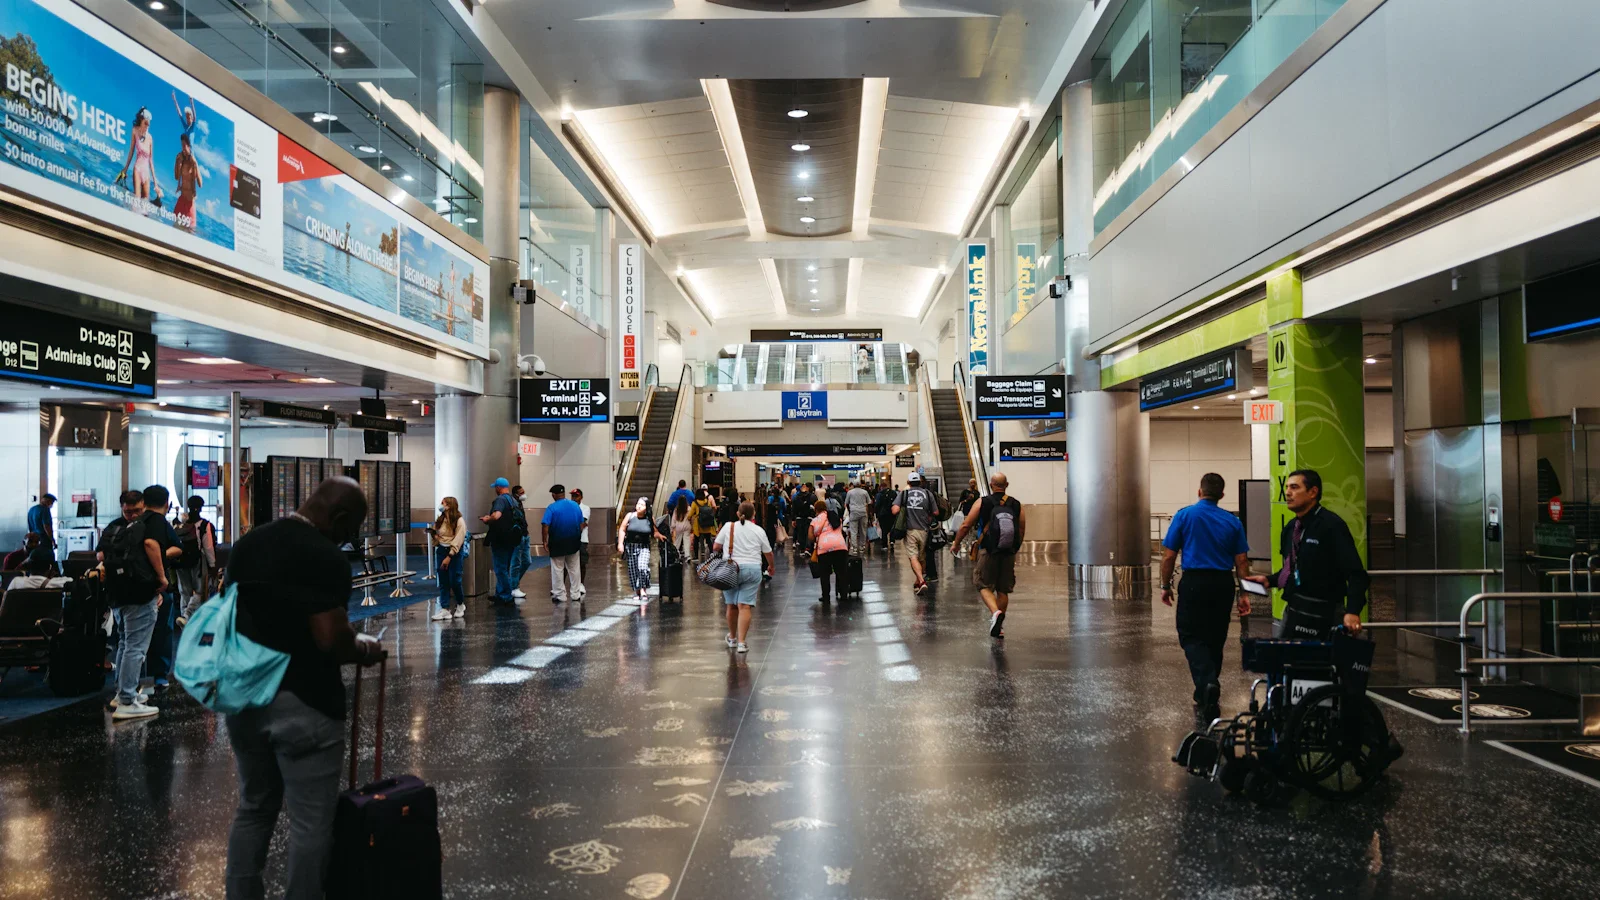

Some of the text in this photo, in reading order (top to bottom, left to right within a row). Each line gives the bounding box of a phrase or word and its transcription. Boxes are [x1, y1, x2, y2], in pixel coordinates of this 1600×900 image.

[6, 62, 126, 144] BEGINS HERE
[5, 98, 29, 119] with
[31, 110, 65, 135] 50,000
[5, 114, 67, 154] bonus miles.
[5, 141, 19, 159] $0
[21, 147, 45, 169] intro
[46, 162, 79, 184] annual
[80, 173, 95, 189] fee
[96, 178, 110, 194] for
[110, 185, 124, 201] the
[125, 191, 141, 207] first
[141, 198, 160, 217] year,
[160, 204, 177, 222] then
[305, 215, 346, 249] CRUISING
[346, 235, 372, 262] ALONG
[372, 249, 393, 272] THERE
[404, 265, 425, 287] BEGINS
[425, 275, 439, 293] HERE
[969, 255, 987, 353] NewsLink
[80, 327, 117, 348] D1-D25
[626, 336, 634, 368] one
[5, 357, 18, 368] D12
[45, 345, 117, 371] Admirals Club
[1208, 362, 1218, 374] EXIT
[106, 373, 117, 383] D15
[620, 372, 639, 380] KITCHEN
[550, 380, 578, 391] EXIT
[620, 380, 639, 388] & BAR
[987, 380, 1014, 388] Baggage
[541, 394, 578, 403] Terminal
[801, 397, 809, 408] 2
[1003, 395, 1033, 403] Transport
[280, 407, 322, 420] FLIGHT INFORMATION
[542, 407, 578, 416] F, G, H, J
[796, 409, 822, 418] skytrain
[1251, 404, 1275, 421] EXIT
[616, 422, 636, 431] D25
[523, 443, 537, 454] EXIT
[615, 442, 626, 450] EXIT
[1295, 625, 1319, 636] envoy
